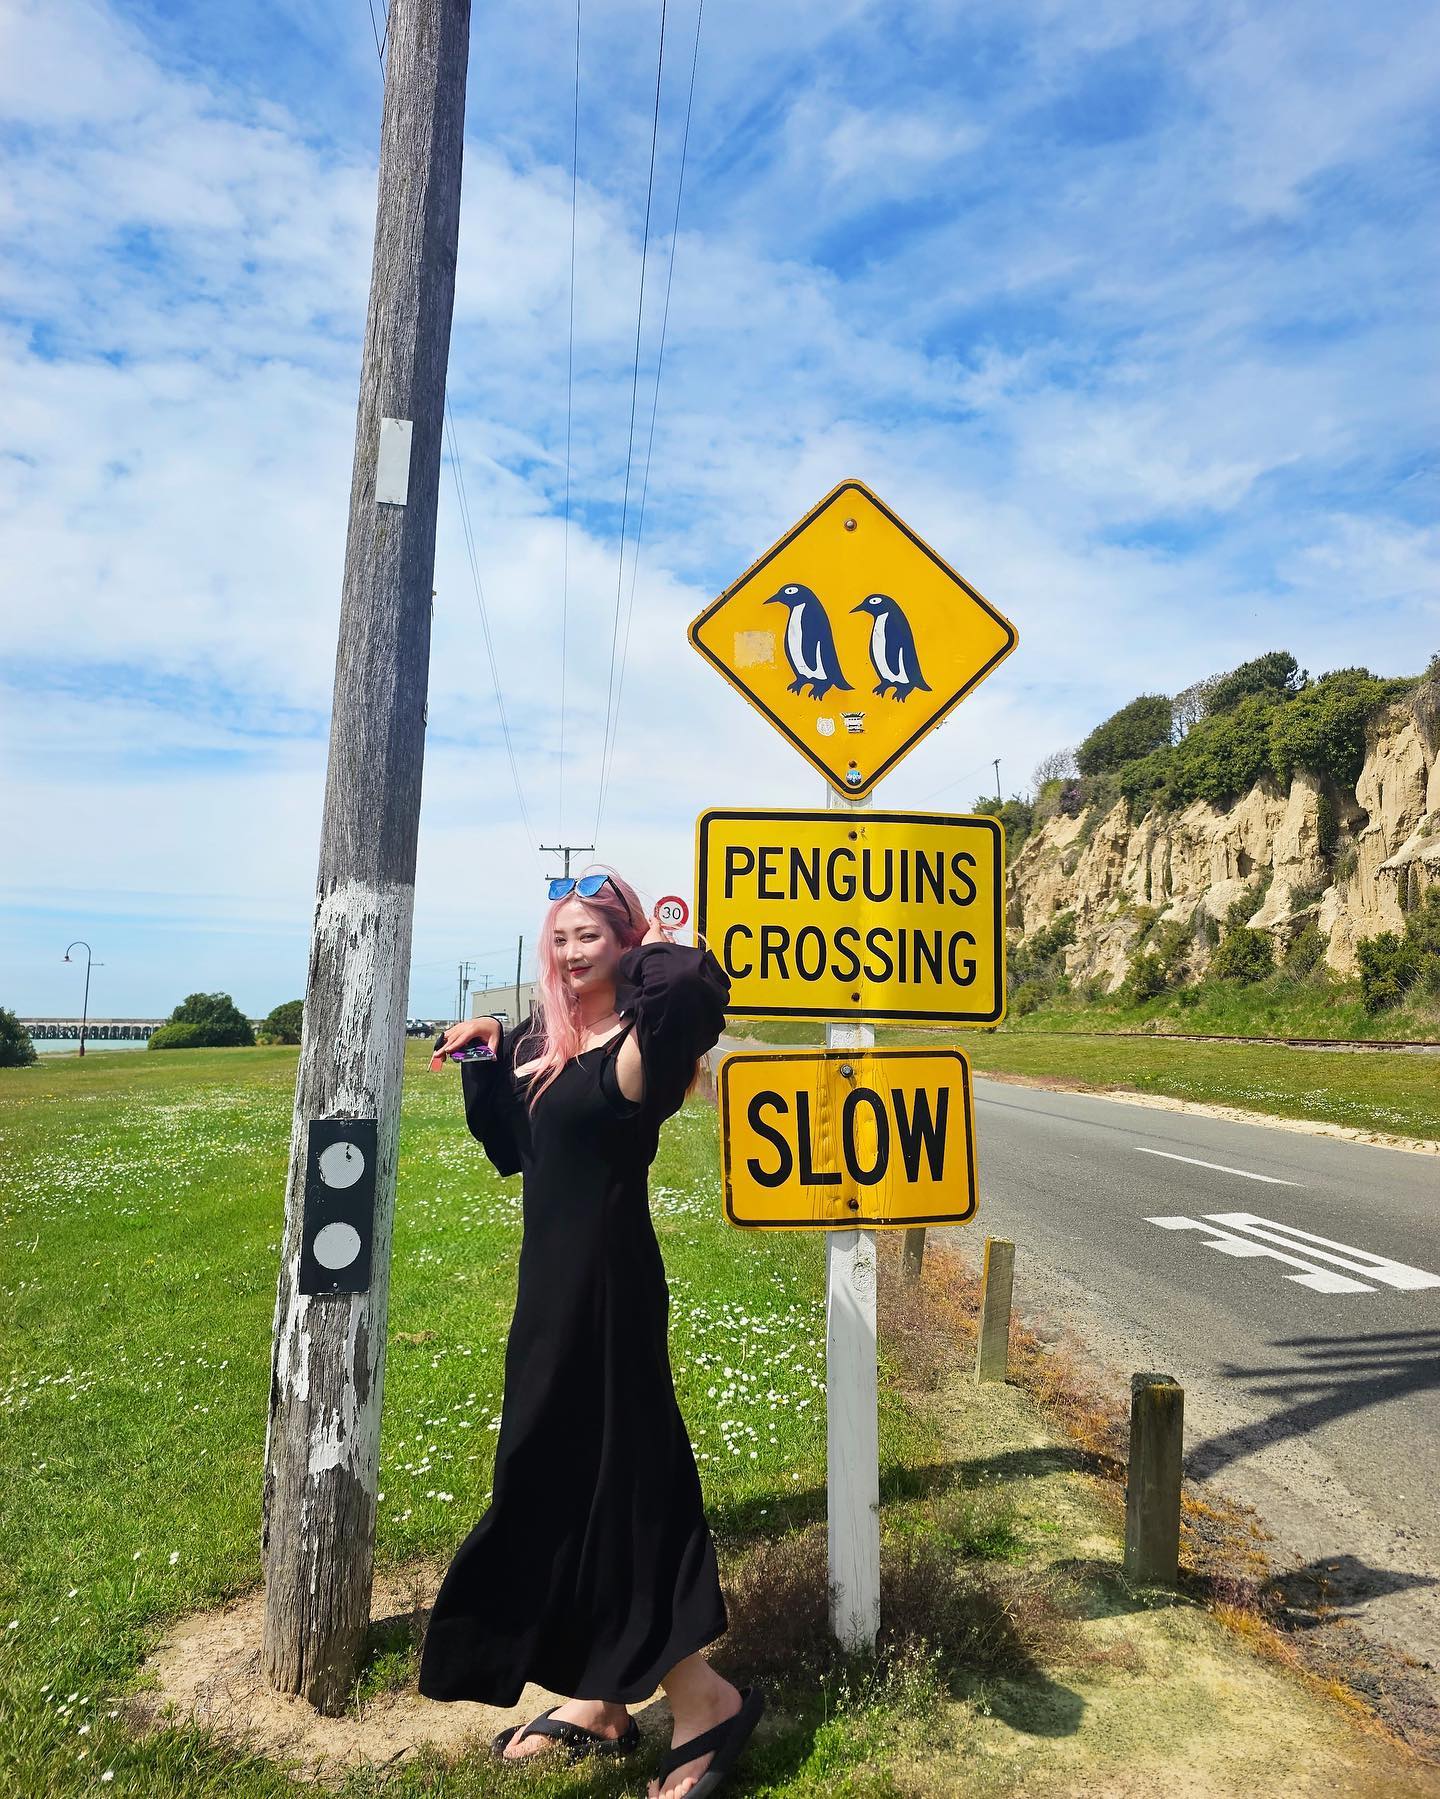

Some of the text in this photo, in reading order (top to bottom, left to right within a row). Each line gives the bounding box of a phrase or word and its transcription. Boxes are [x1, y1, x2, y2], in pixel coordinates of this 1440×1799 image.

[724, 846, 977, 907] PENGUINS
[662, 906, 681, 920] 30
[723, 924, 977, 987] CROSSING
[746, 1087, 950, 1188] SLOW
